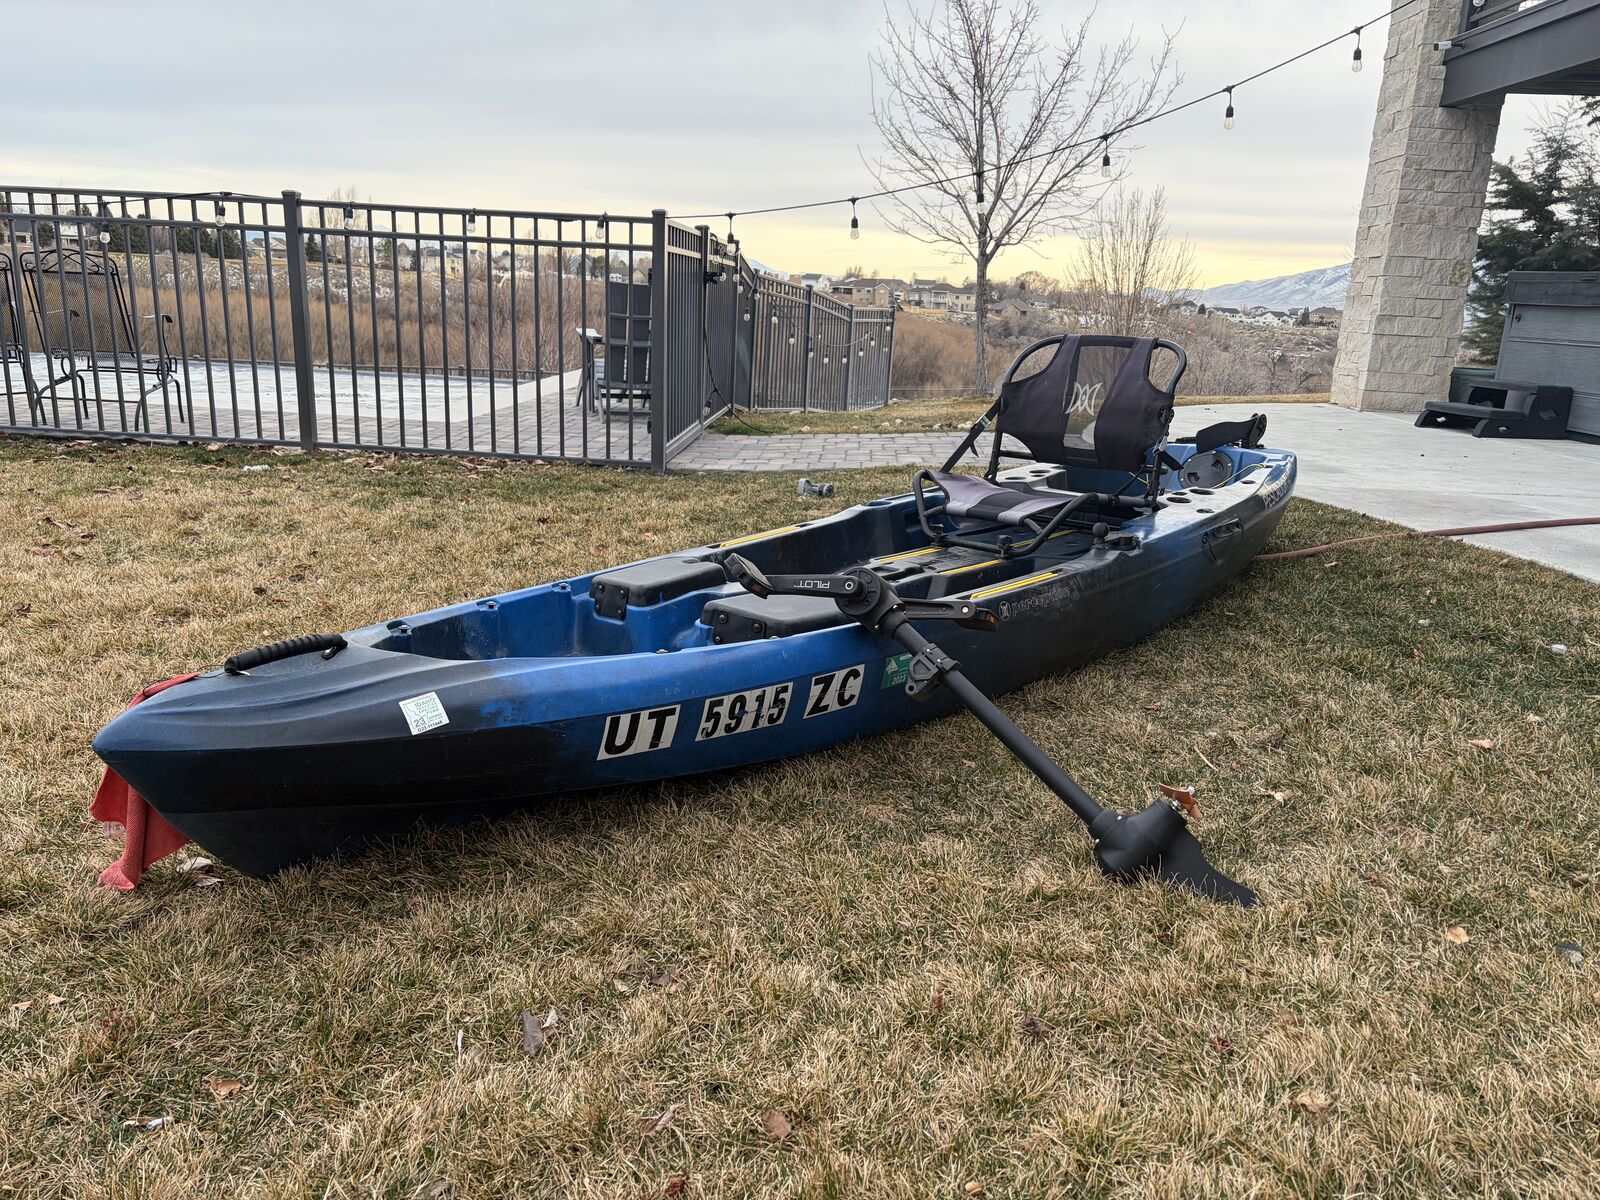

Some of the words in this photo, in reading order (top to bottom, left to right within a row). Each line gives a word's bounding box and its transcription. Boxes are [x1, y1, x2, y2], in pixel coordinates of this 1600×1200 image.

[414, 697, 436, 709] IDAHO
[603, 707, 677, 756] UT
[700, 685, 790, 739] 5915
[806, 668, 862, 717] ZC
[413, 717, 426, 728] 23
